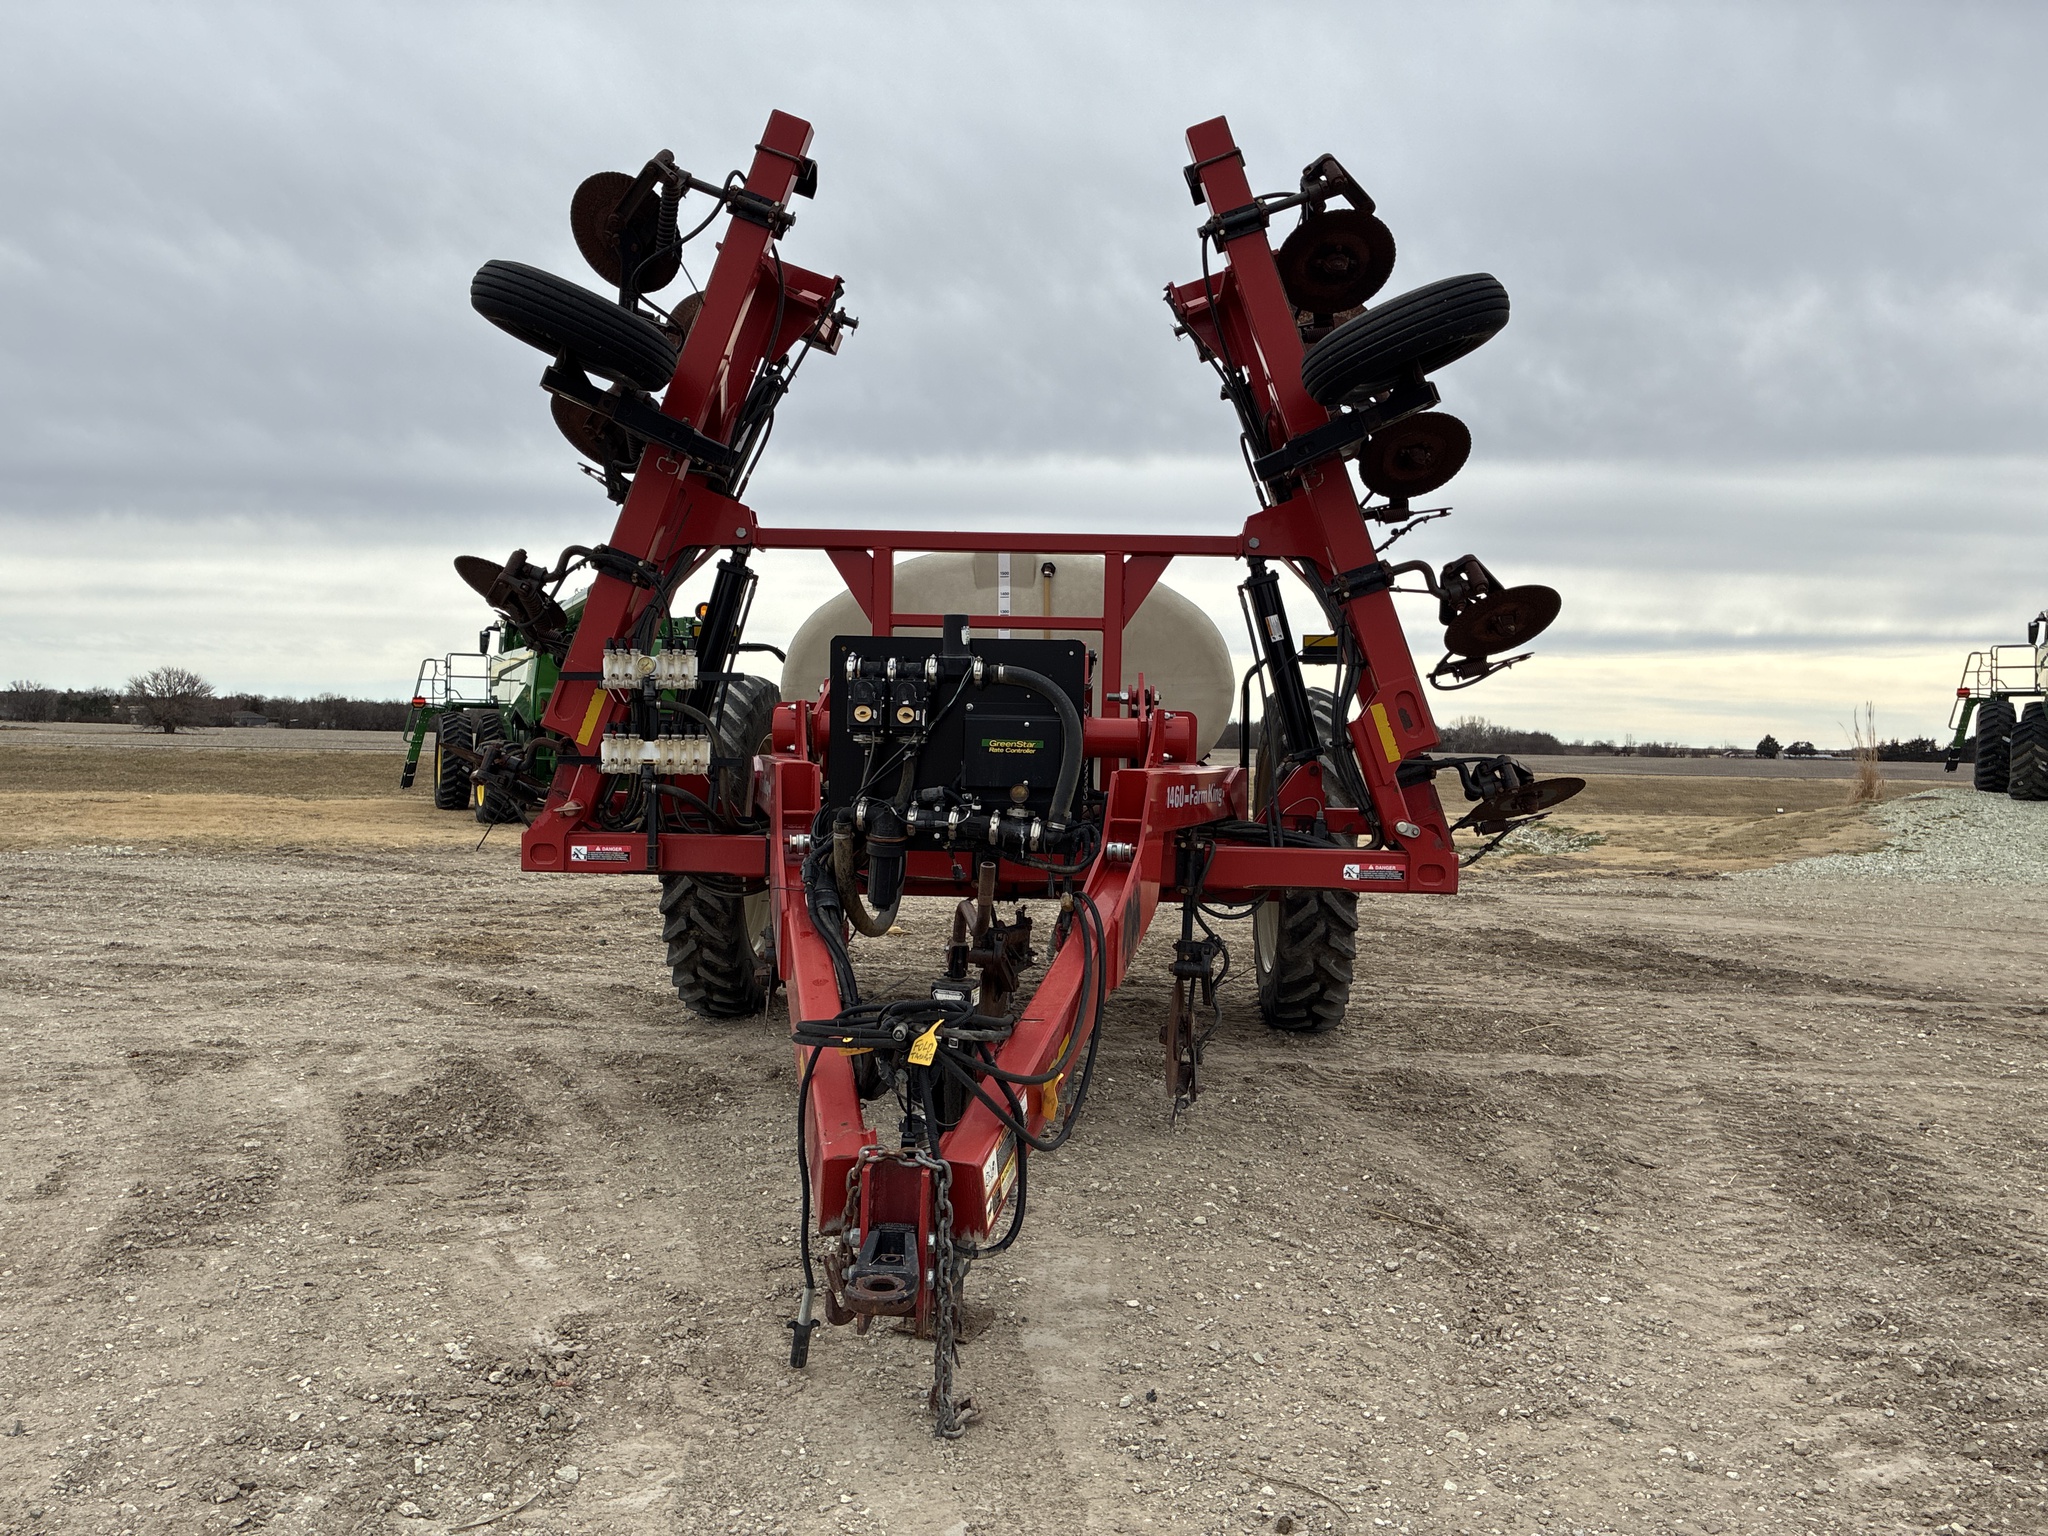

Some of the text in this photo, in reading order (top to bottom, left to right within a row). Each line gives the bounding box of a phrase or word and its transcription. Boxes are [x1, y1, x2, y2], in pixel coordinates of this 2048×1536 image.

[989, 739, 1036, 748] GreenStar
[1166, 785, 1185, 809] 1460
[912, 1038, 934, 1053] FOLD
